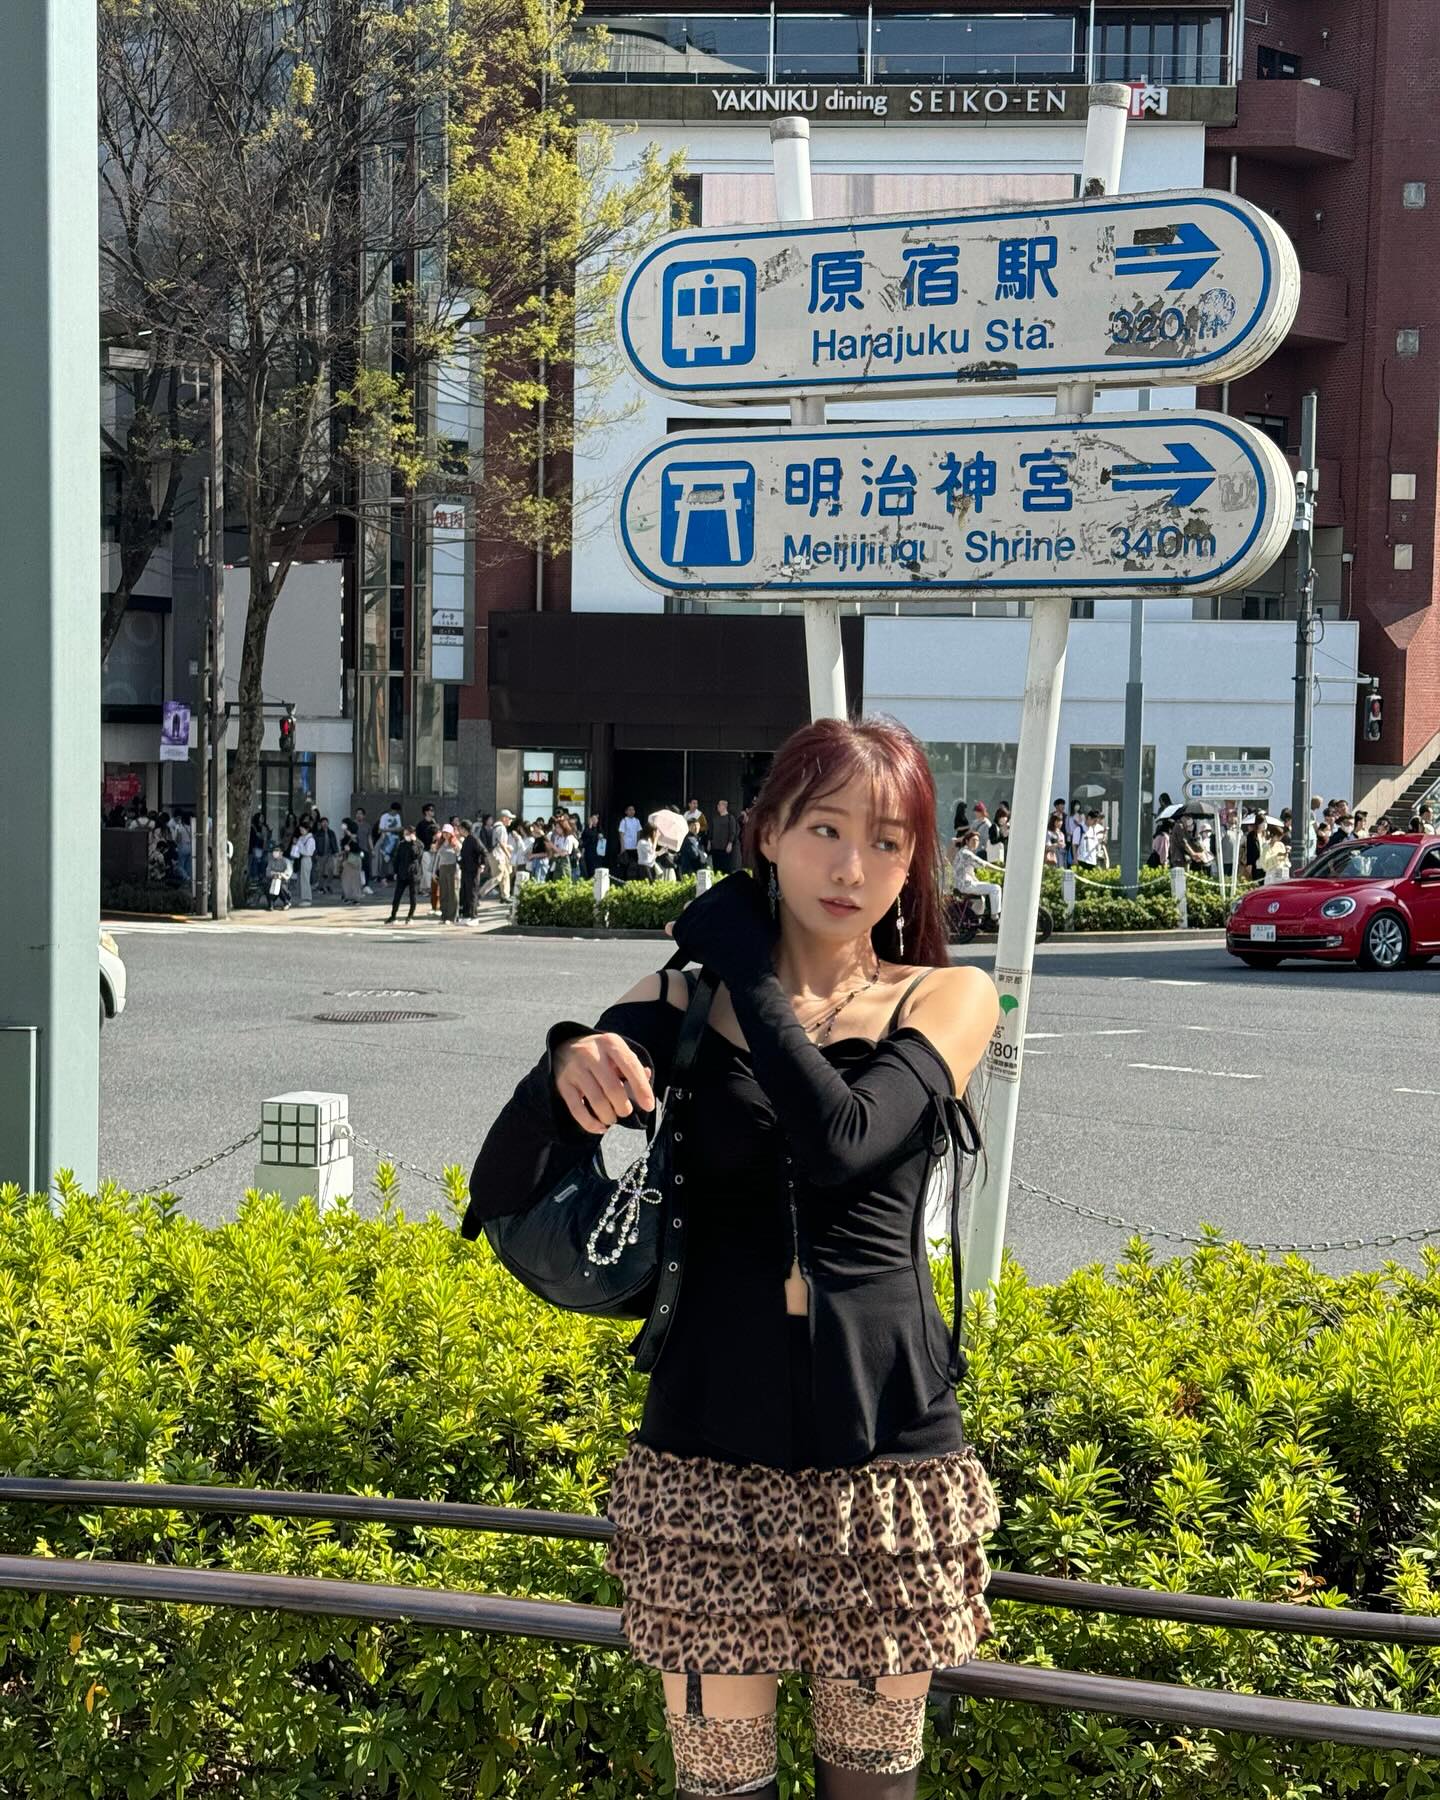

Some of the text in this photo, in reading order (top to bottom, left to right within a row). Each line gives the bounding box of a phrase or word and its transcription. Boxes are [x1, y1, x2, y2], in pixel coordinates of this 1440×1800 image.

[712, 89, 1066, 115] YAKINIKU dining SEIKO-EN
[808, 236, 1059, 313] 原宿駅
[813, 317, 1055, 364] Harajuku Sta.
[784, 448, 1077, 517] 明治神宮
[965, 530, 1076, 564] Shrine
[1111, 525, 1217, 560] 340m
